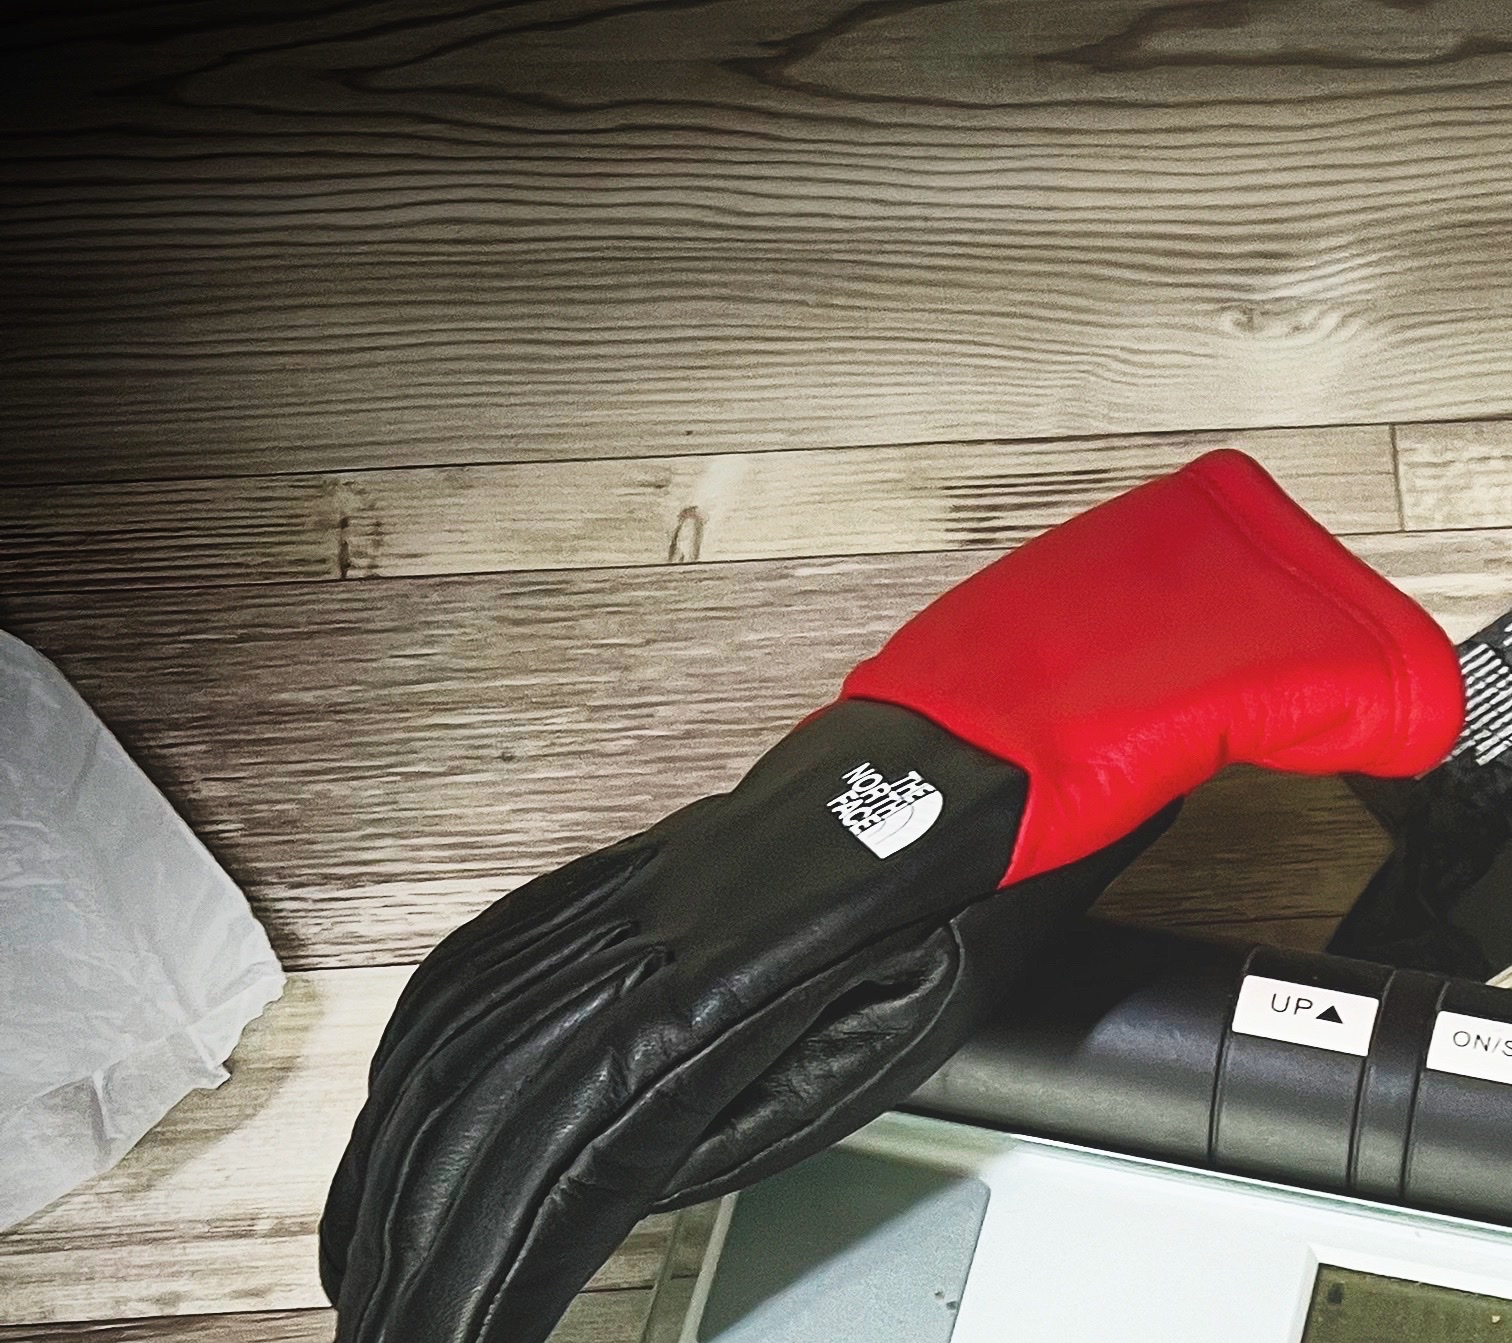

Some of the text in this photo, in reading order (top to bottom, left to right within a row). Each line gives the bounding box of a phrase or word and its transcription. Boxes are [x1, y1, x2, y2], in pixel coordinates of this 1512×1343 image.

[841, 762, 908, 821] NORTH
[887, 770, 937, 804] THE
[826, 789, 885, 836] FACE
[1270, 993, 1314, 1016] UP
